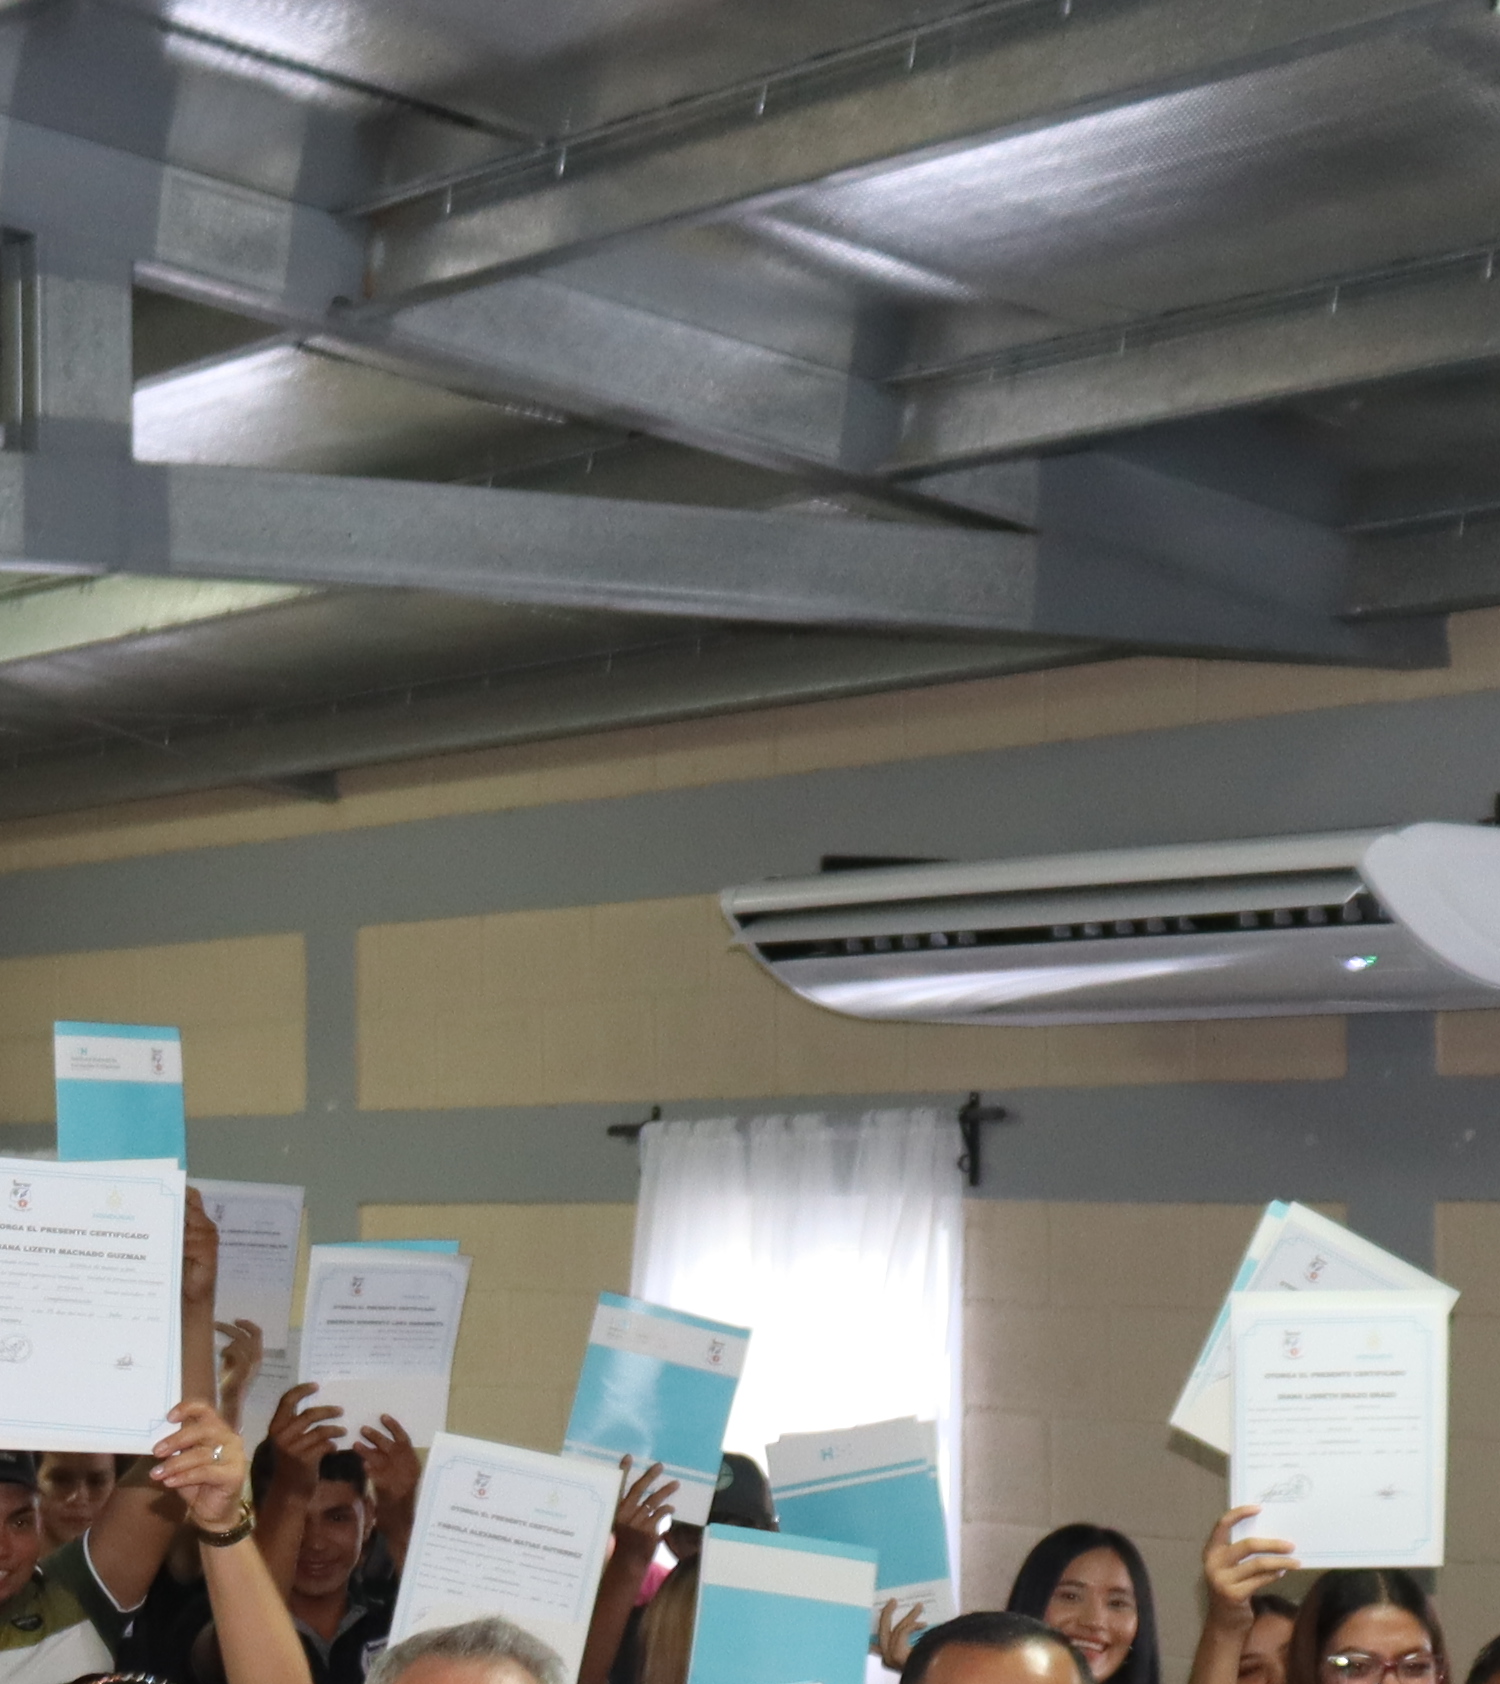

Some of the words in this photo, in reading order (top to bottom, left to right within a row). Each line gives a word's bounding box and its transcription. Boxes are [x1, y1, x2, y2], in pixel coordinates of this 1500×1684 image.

[27, 1225, 37, 1233] EL
[40, 1226, 87, 1236] PRESENTE
[89, 1229, 150, 1240] CERTIFICADO
[23, 1245, 56, 1254] LIZETH
[58, 1248, 104, 1258] MACHADO
